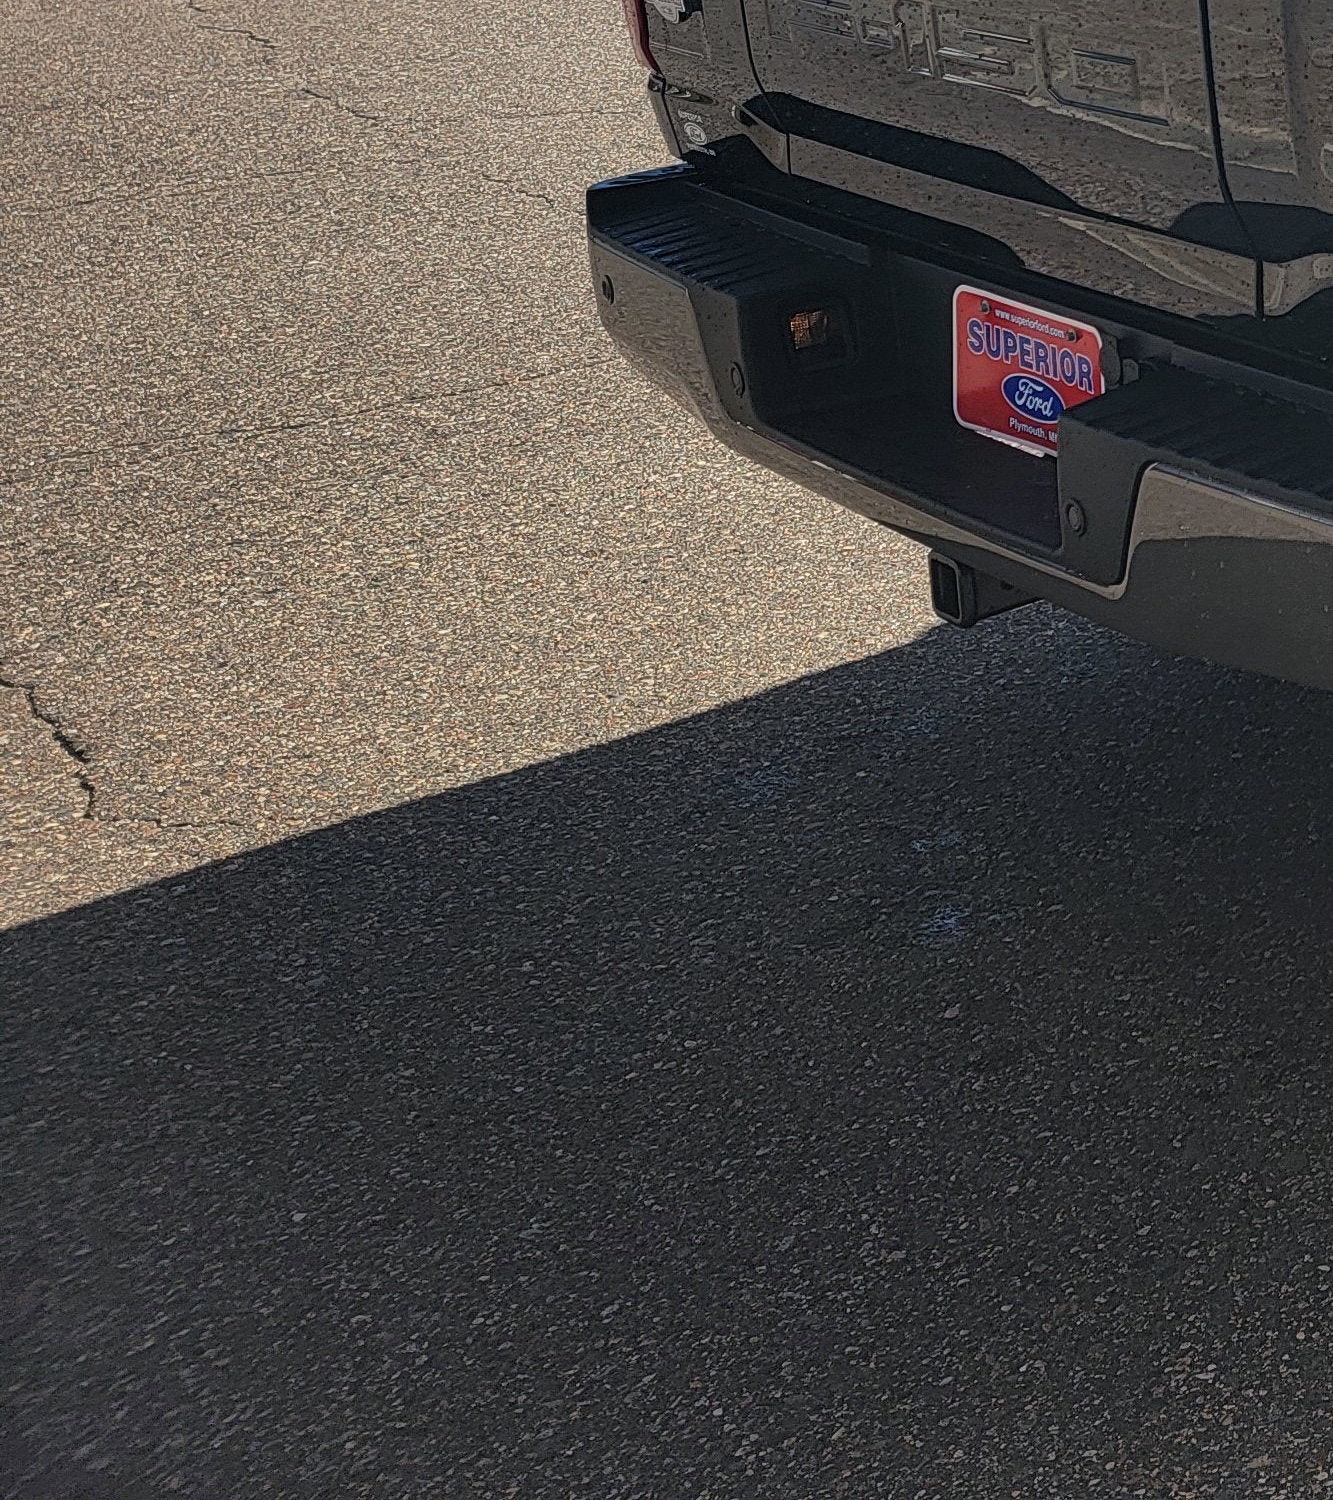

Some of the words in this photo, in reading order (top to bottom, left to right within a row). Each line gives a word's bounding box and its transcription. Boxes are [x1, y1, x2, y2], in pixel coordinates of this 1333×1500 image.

[967, 317, 1095, 395] SUPERIOR
[1014, 378, 1054, 418] Ford
[1009, 417, 1048, 441] Plymouth,
